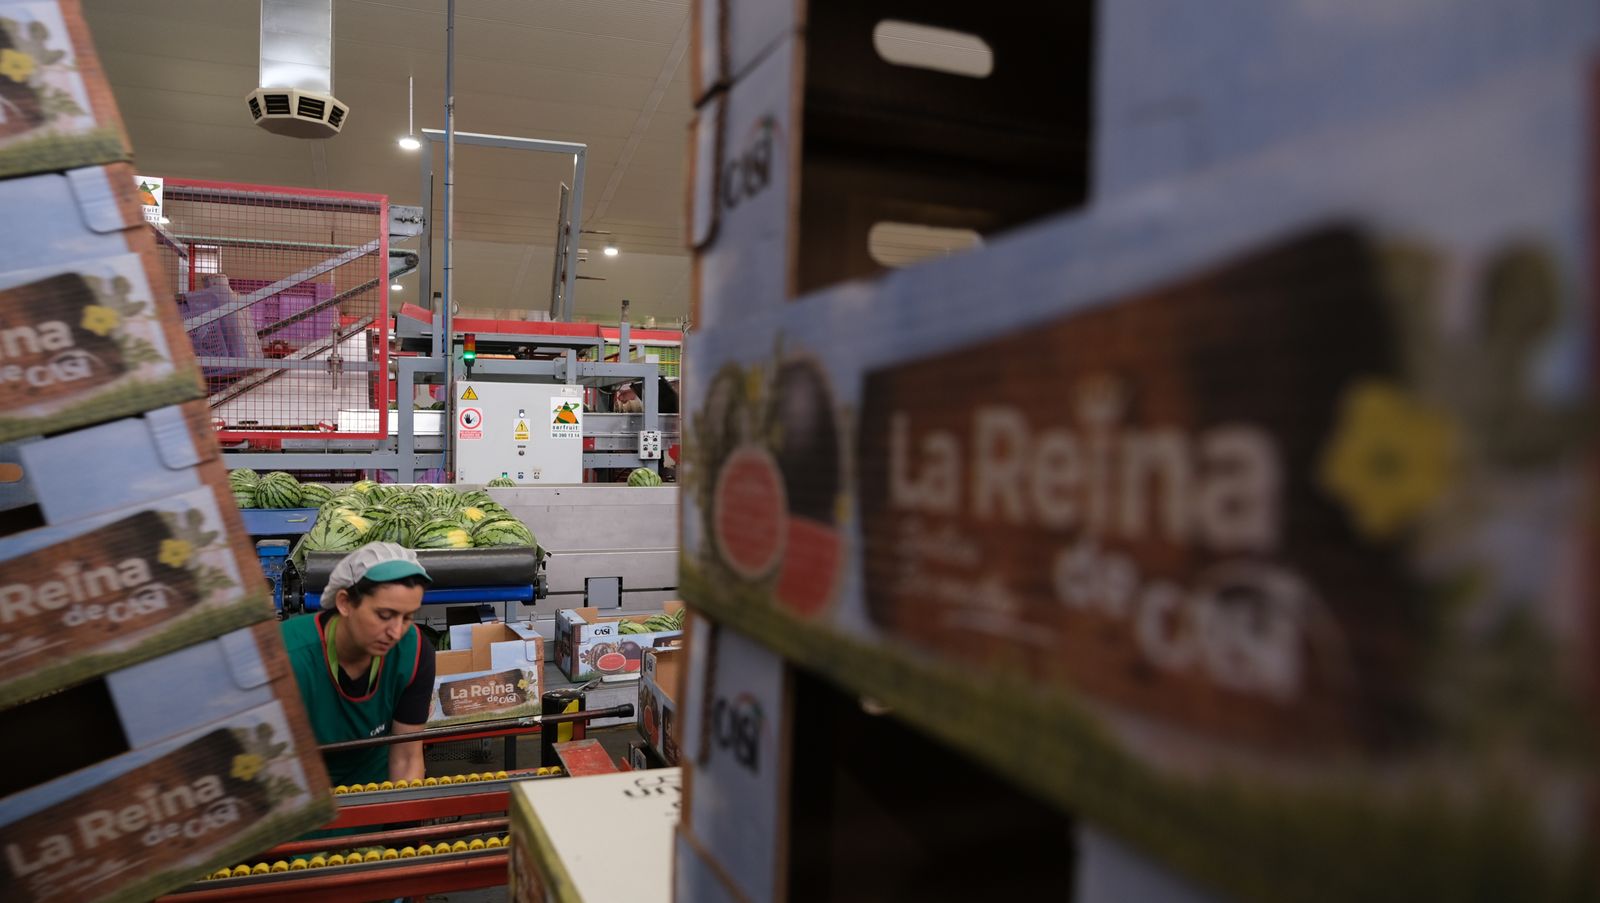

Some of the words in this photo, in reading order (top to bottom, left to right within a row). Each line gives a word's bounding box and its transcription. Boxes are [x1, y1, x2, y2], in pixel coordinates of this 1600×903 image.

[890, 411, 961, 511] La
[971, 376, 1282, 552] Reina
[0, 556, 152, 623] Reina
[594, 628, 611, 636] CASI
[450, 687, 468, 700] La
[471, 681, 514, 697] Reina
[487, 695, 498, 703] de
[6, 833, 75, 878] La
[76, 774, 225, 849] Reina
[142, 820, 181, 847] de
